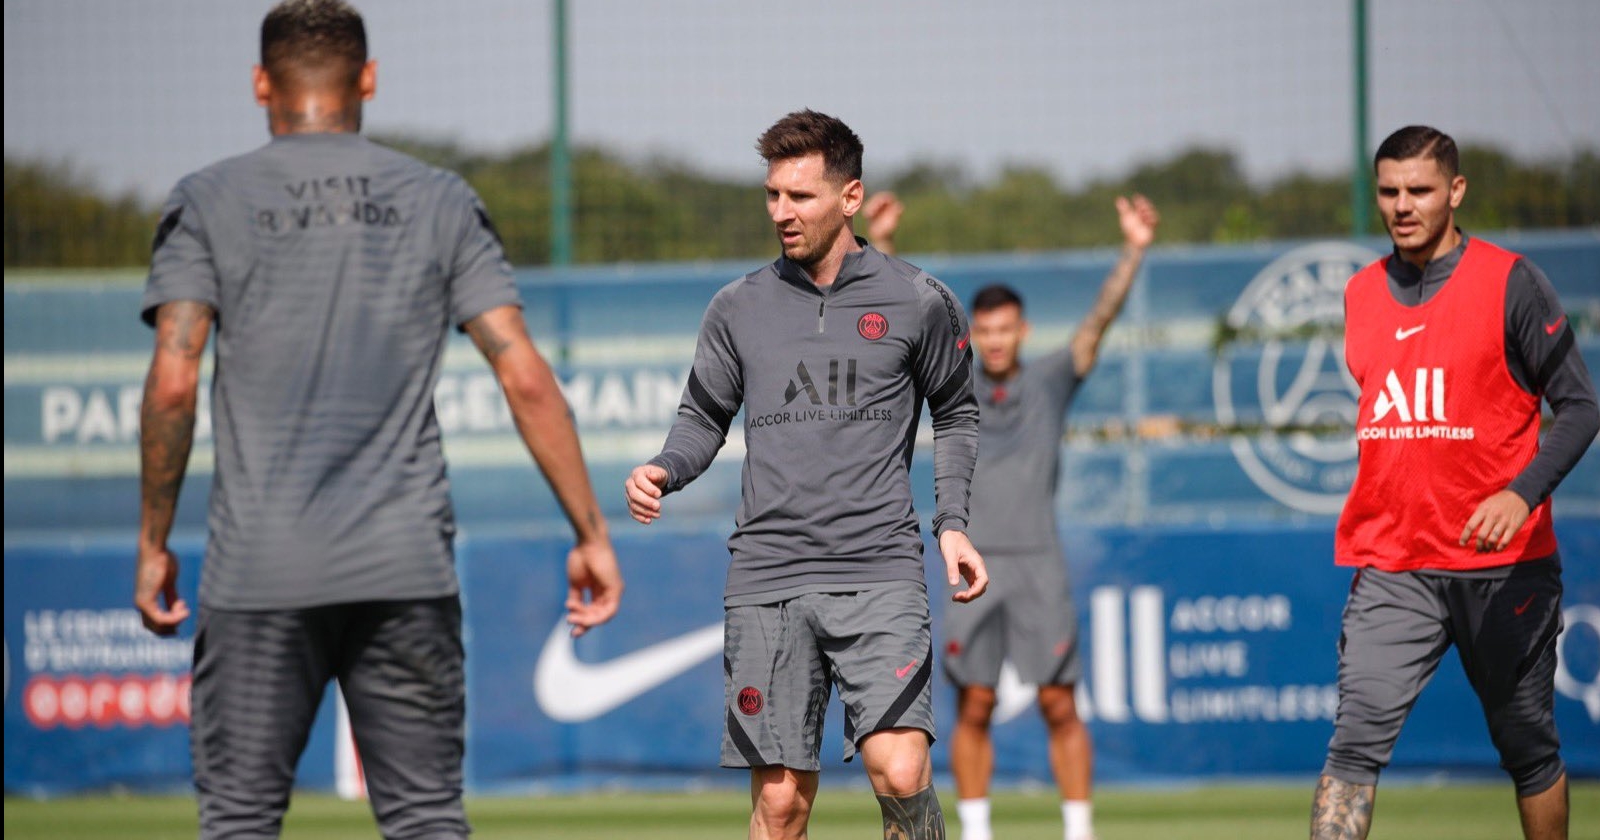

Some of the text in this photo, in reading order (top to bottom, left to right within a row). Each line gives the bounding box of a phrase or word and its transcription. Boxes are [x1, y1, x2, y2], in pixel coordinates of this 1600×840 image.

[285, 175, 371, 200] VISIT
[750, 409, 892, 428] ACCOR LIVE LIMITLESS
[1389, 426, 1414, 439] LIVE
[1416, 426, 1475, 440] LIMITLESS
[1170, 594, 1291, 632] ACCOR
[1169, 640, 1249, 678] LIVE
